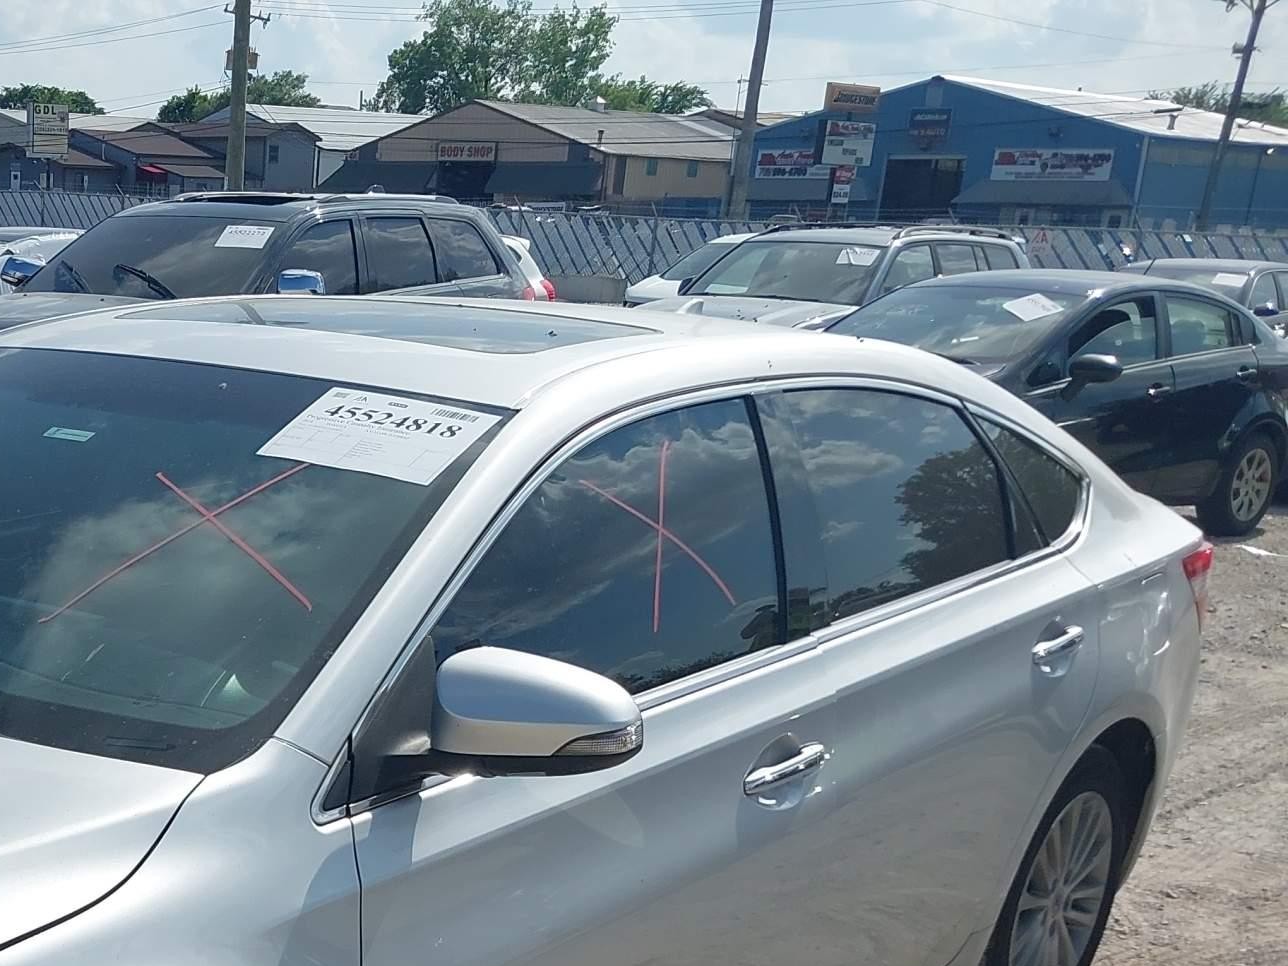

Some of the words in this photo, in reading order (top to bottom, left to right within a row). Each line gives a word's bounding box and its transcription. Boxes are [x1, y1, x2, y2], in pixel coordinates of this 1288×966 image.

[34, 104, 57, 116] GDL
[440, 146, 465, 158] BODY
[467, 146, 493, 158] SHOP
[324, 404, 463, 438] 45524818
